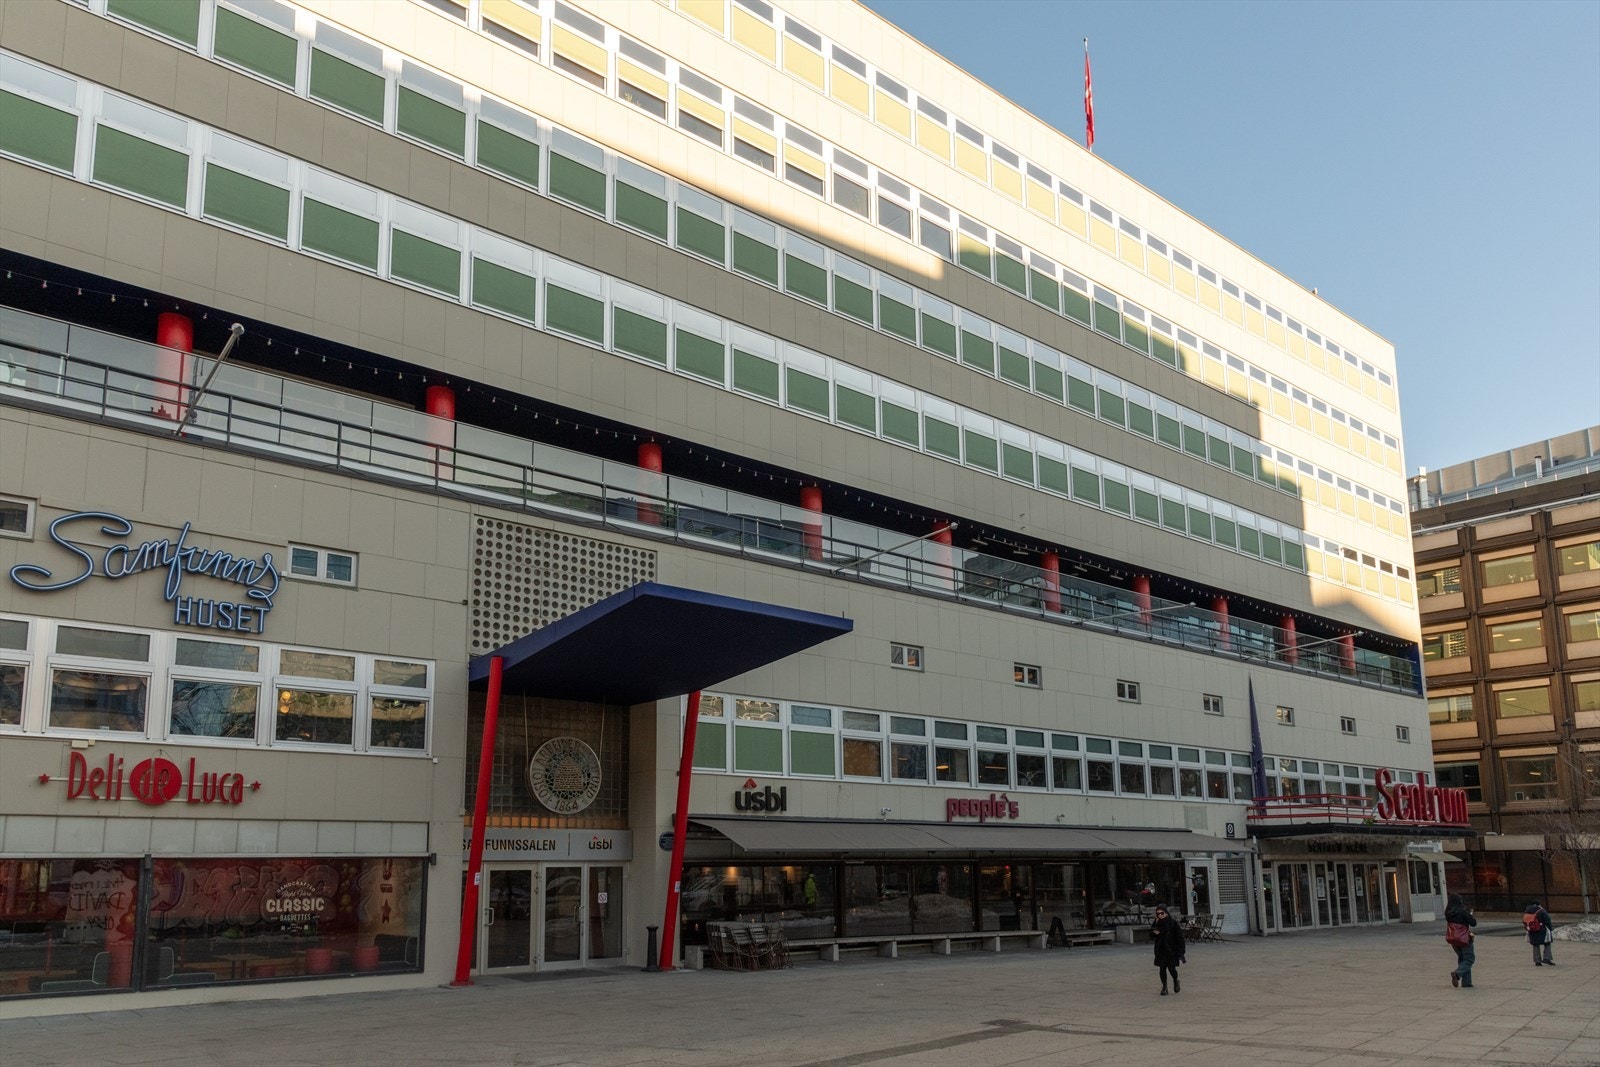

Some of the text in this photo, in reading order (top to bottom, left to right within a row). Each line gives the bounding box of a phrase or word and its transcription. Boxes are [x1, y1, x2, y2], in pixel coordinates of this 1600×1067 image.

[10, 511, 280, 607] Samfunns
[174, 595, 272, 634] HUSET
[66, 751, 124, 801] Deli
[187, 757, 244, 803] Luca
[554, 799, 579, 812] 1864
[946, 793, 1019, 823] people's
[1375, 767, 1469, 823] Sentrum
[276, 880, 316, 894] HANDCRAFTED
[265, 897, 325, 913] CLASSIC
[279, 913, 311, 922] BAGUETTES
